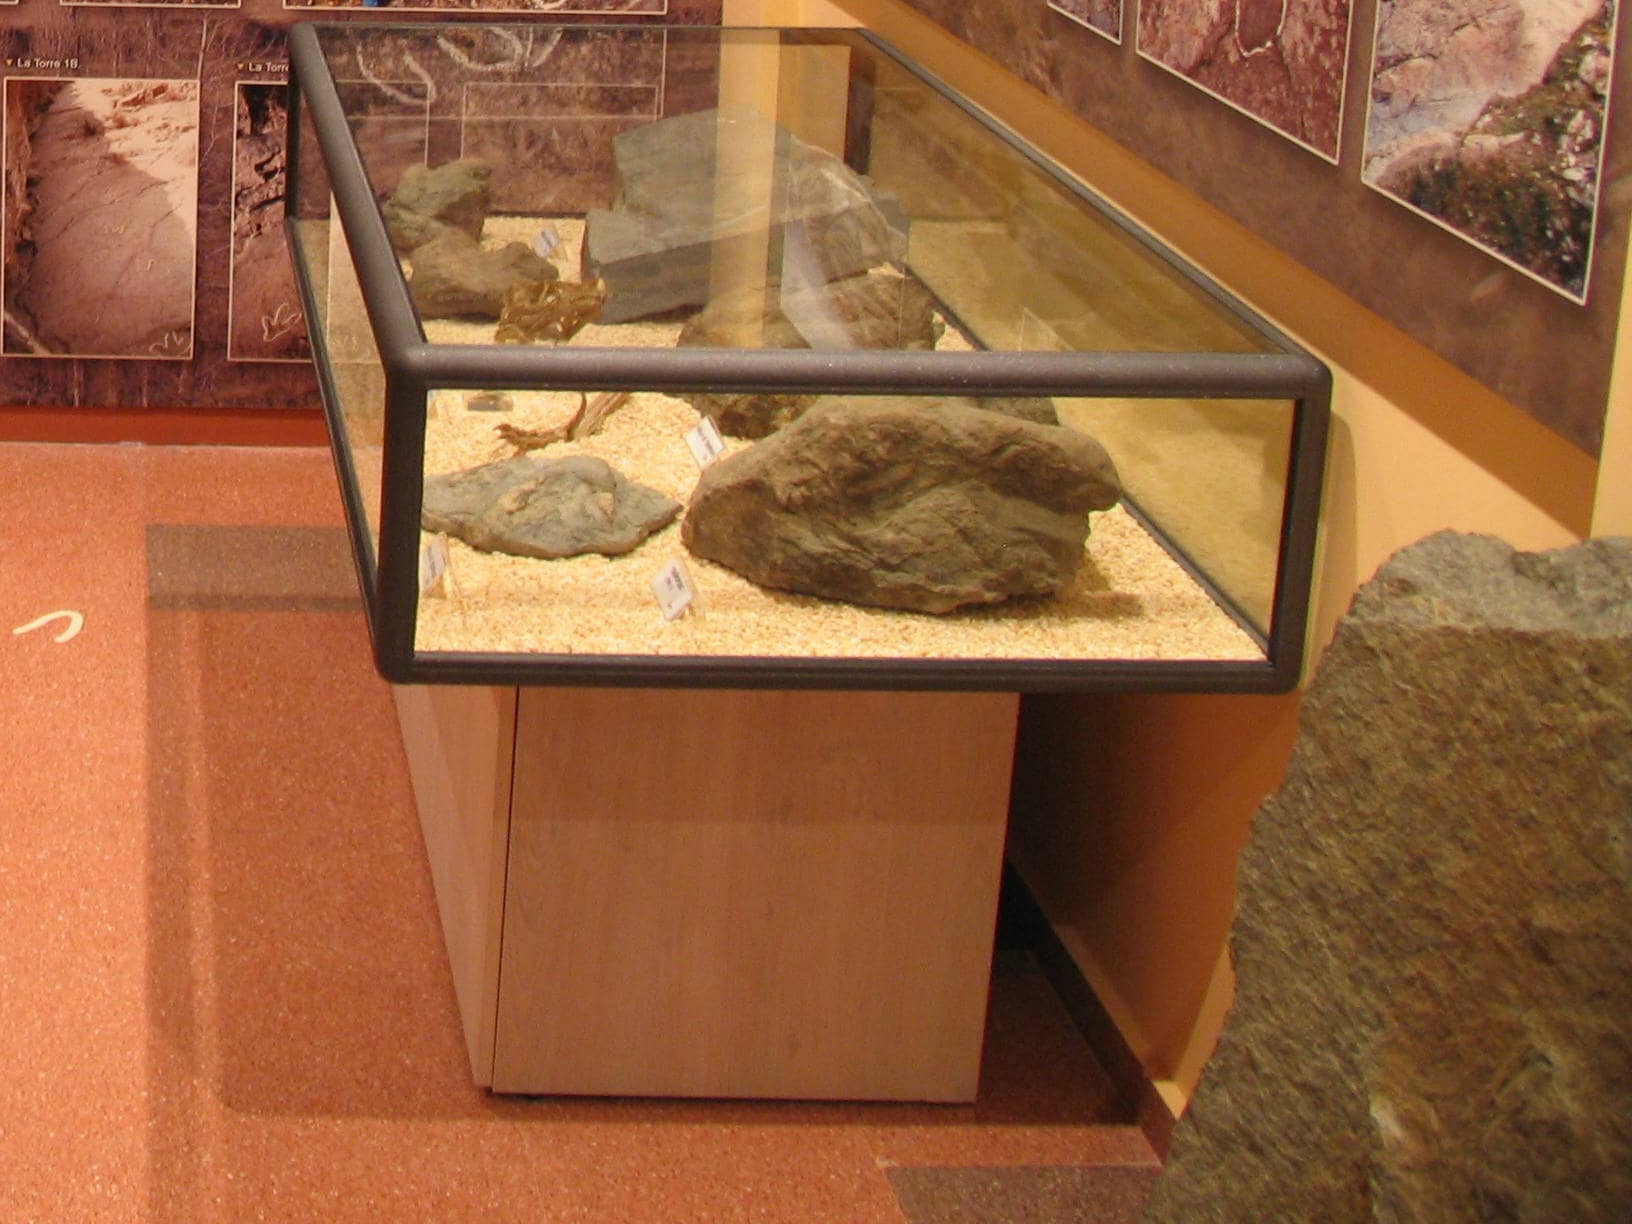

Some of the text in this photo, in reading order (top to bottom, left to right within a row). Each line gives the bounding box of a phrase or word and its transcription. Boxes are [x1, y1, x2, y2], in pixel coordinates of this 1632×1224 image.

[17, 57, 31, 68] La
[34, 58, 61, 69] Torre
[248, 62, 262, 72] La
